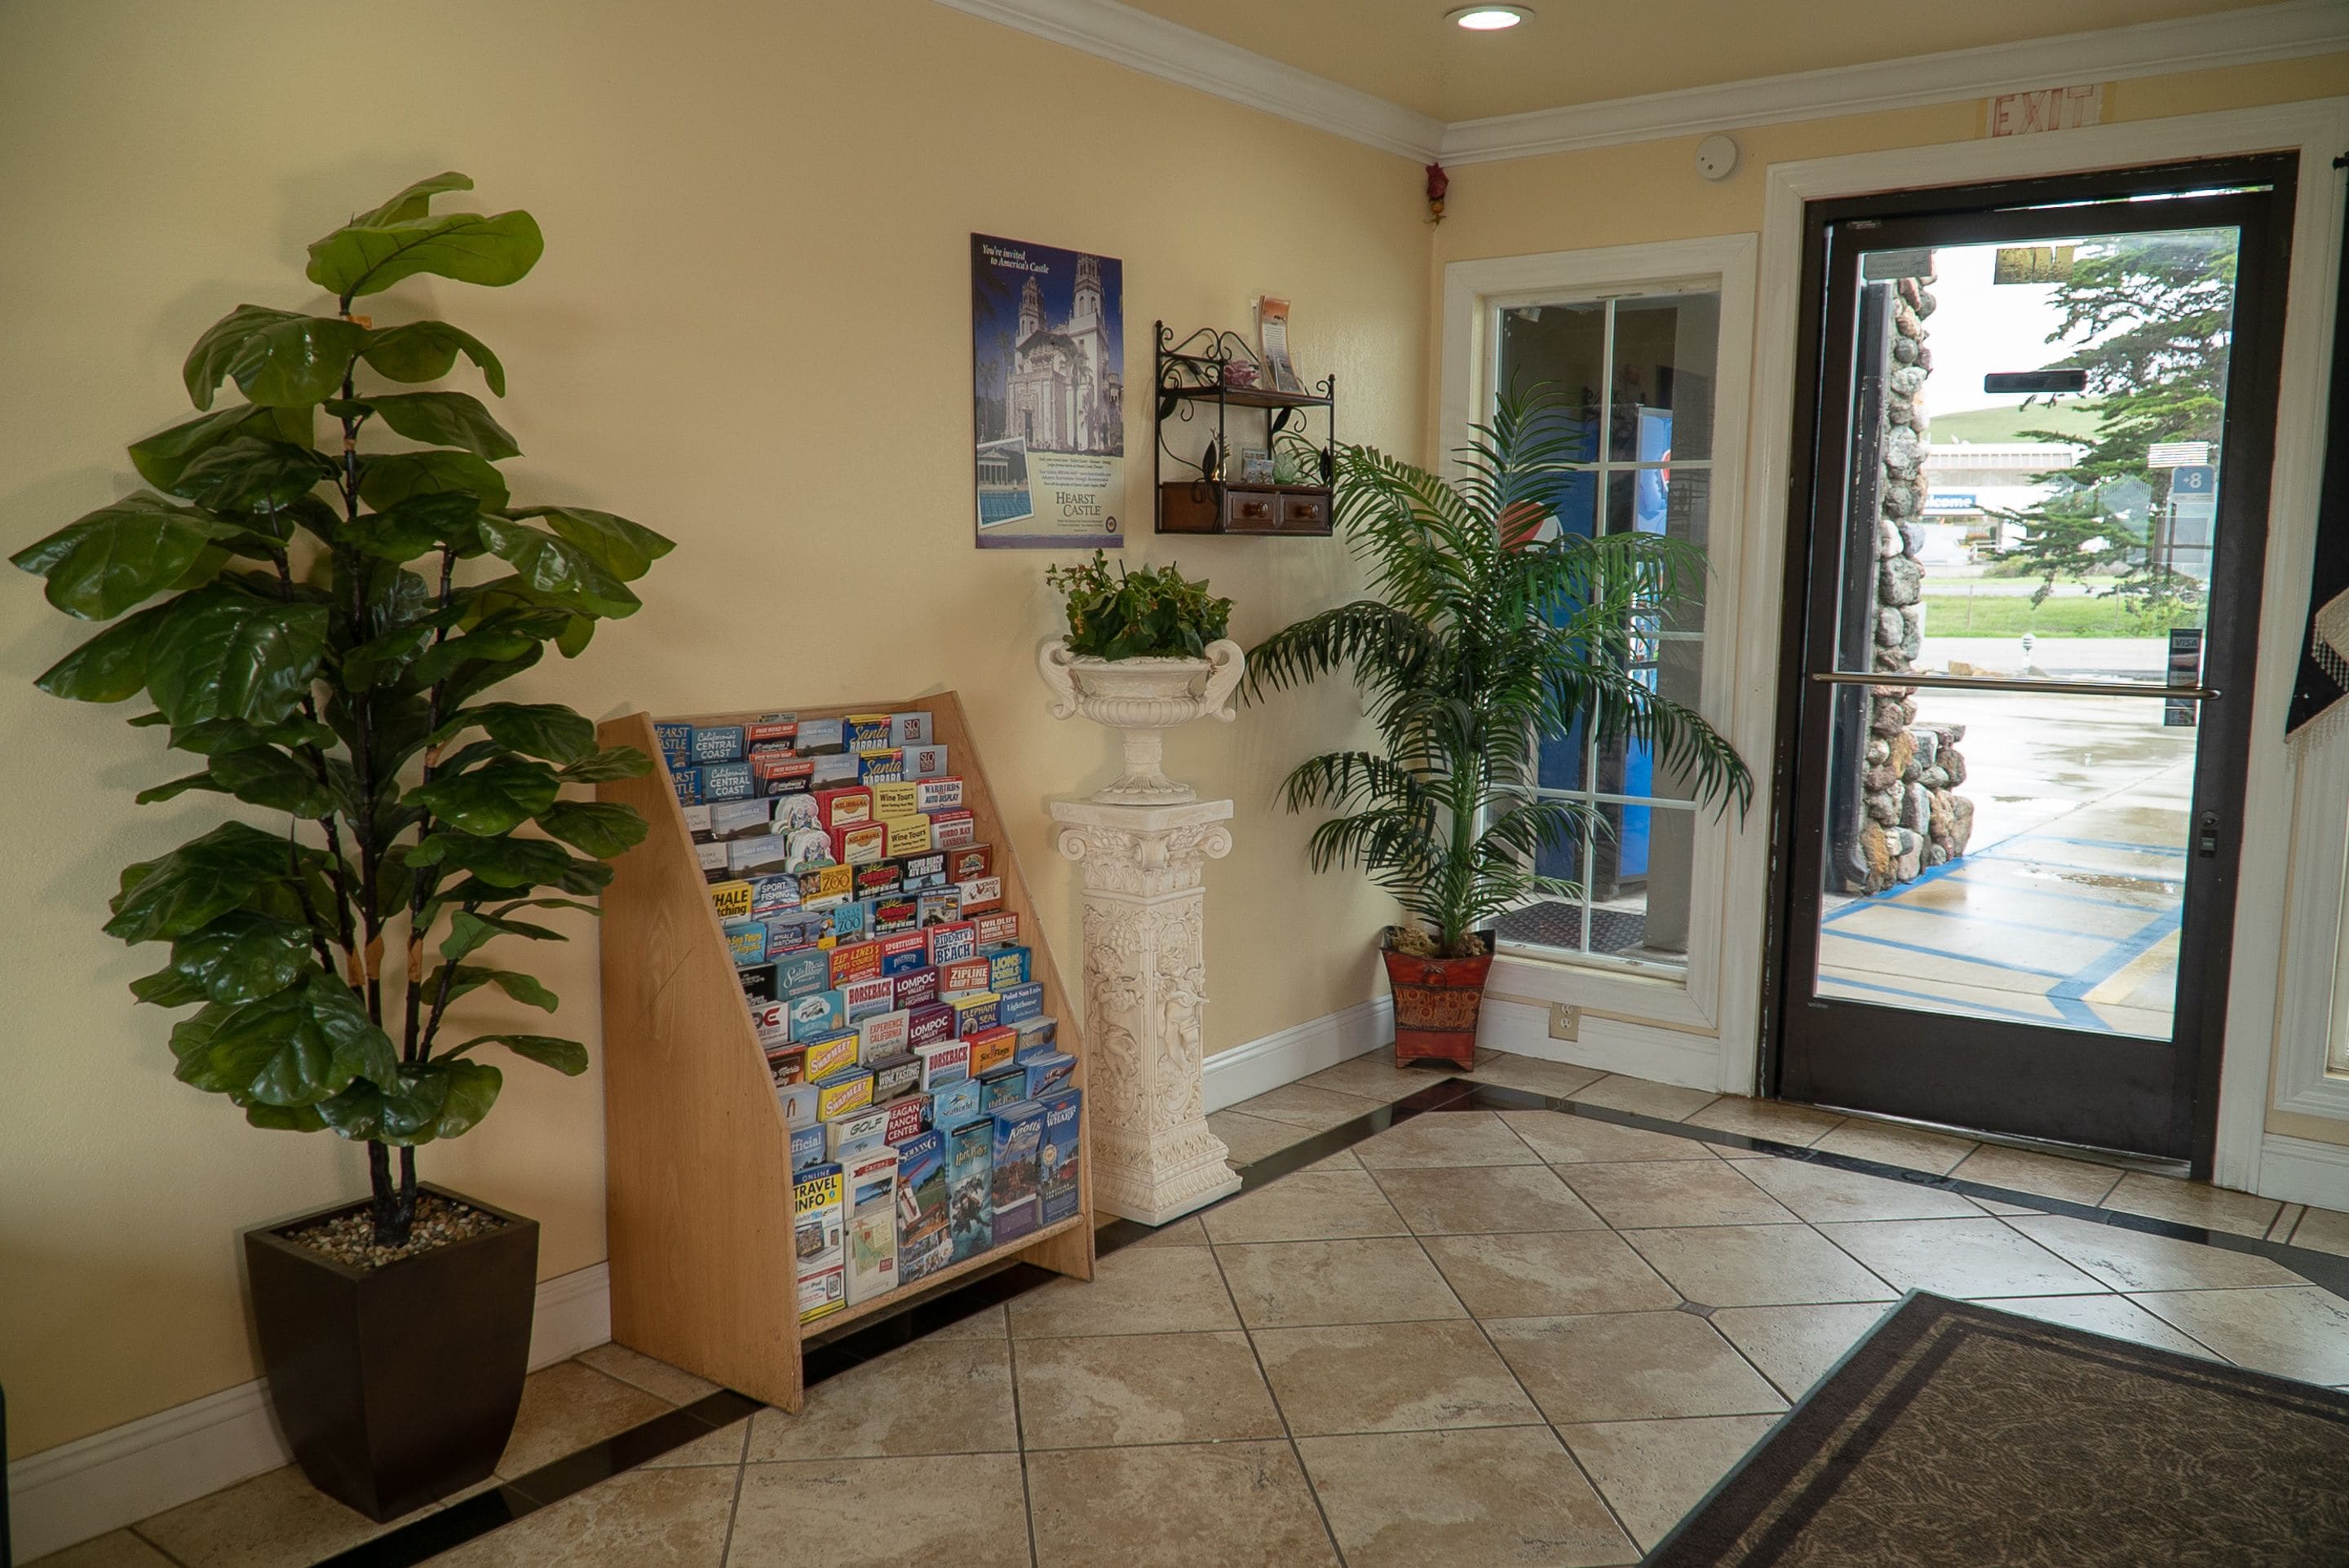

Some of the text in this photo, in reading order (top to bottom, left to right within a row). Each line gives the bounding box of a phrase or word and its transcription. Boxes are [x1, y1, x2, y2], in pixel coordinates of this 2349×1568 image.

[1993, 84, 2094, 138] EXIT
[983, 244, 1025, 261] You're invited
[990, 257, 1050, 274] to America's Castle
[1055, 492, 1095, 504] HEARST
[1063, 504, 1102, 517] CASTLE
[2175, 638, 2197, 647] VISA
[905, 719, 920, 730] SLO
[856, 725, 889, 741] Santa
[659, 738, 687, 749] ASTLE
[696, 740, 737, 751] CENTRAL
[850, 738, 887, 752] BARBARA
[701, 749, 731, 759] COAST
[868, 759, 902, 775] Santa
[710, 777, 751, 788] CENTRAL
[925, 783, 960, 794] WARBIRDS
[715, 785, 745, 796] COAST
[880, 793, 914, 802] Wine Tours
[925, 793, 959, 804] AUTO DISPLAY
[891, 828, 926, 842] Wine Tours
[761, 881, 786, 893] SPORT
[822, 874, 849, 891] ZOO
[761, 890, 790, 901] FISHING
[717, 905, 747, 917] tching
[838, 917, 860, 933] ZOO
[980, 916, 1017, 929] WILDLIFE
[744, 933, 763, 942] Tours
[936, 943, 971, 965] BEACH
[951, 967, 989, 980] ZIPLINE
[897, 972, 936, 992] LOMPOC
[849, 981, 891, 1005] HORSEBACK
[907, 984, 926, 995] VALLEY
[1002, 986, 1041, 1002] Point San Luis
[962, 1003, 997, 1019] ELEPHANT
[1007, 999, 1037, 1012] Lighthouse
[980, 1013, 997, 1024] SEAL
[870, 1017, 904, 1035] EXPERIENCE
[910, 1016, 949, 1039] LOMPOC
[870, 1027, 901, 1044] CALIFORNIA
[921, 1028, 939, 1040] VALLEY
[930, 1045, 968, 1071] HORSEBACK
[993, 1045, 1010, 1058] Flags
[878, 1070, 896, 1089] WINE
[896, 1065, 920, 1082] TASTING
[889, 1114, 918, 1130] RANCH
[1046, 1111, 1074, 1127] WHARF
[850, 1117, 883, 1136] GOLF
[887, 1124, 918, 1141] CENTER
[1008, 1119, 1042, 1143] Knott's
[791, 1132, 821, 1153] fficial
[802, 1169, 830, 1182] ONLINE
[794, 1177, 837, 1199] TRAVEL
[794, 1193, 825, 1213] INFO
